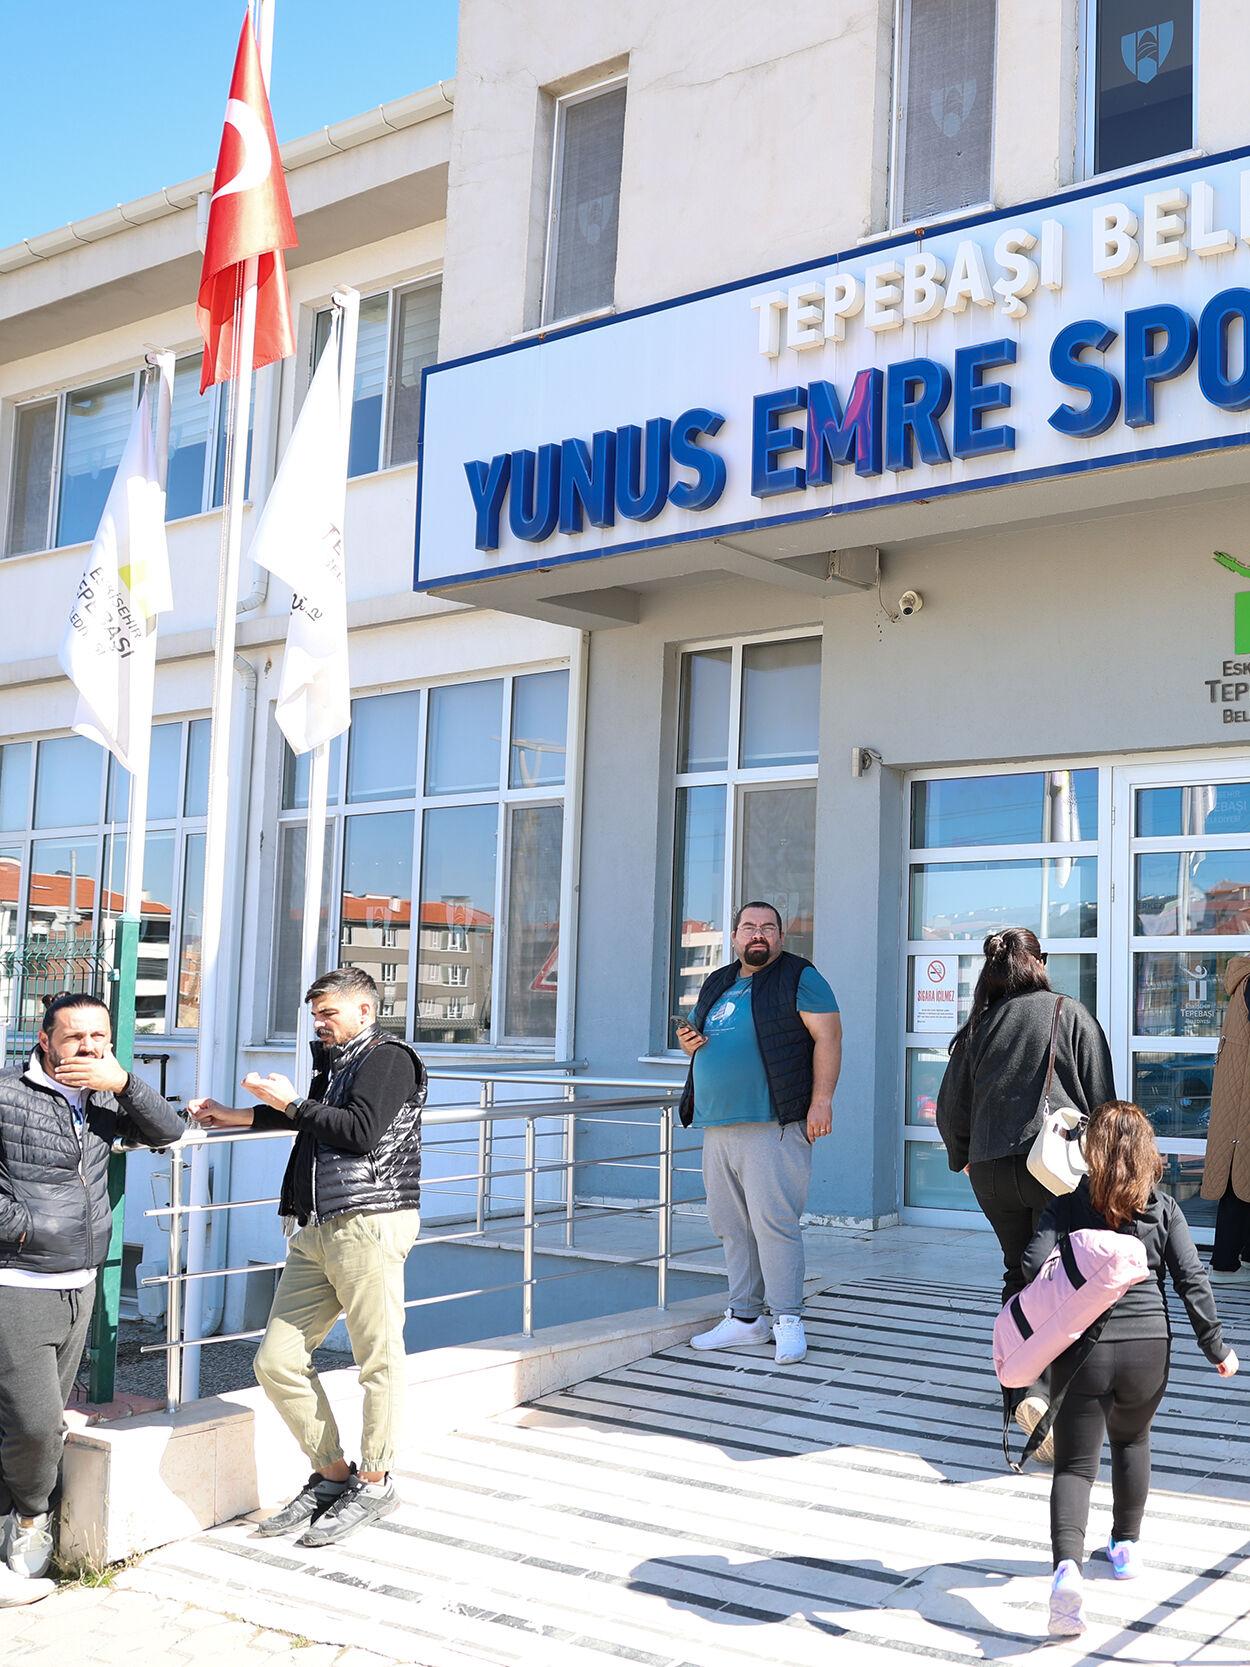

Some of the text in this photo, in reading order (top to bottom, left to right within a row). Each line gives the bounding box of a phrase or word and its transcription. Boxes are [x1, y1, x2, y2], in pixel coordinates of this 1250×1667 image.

[751, 219, 1062, 357] TEPEBAŞI
[464, 407, 727, 551] YUNUS
[751, 338, 1017, 498] EMRE
